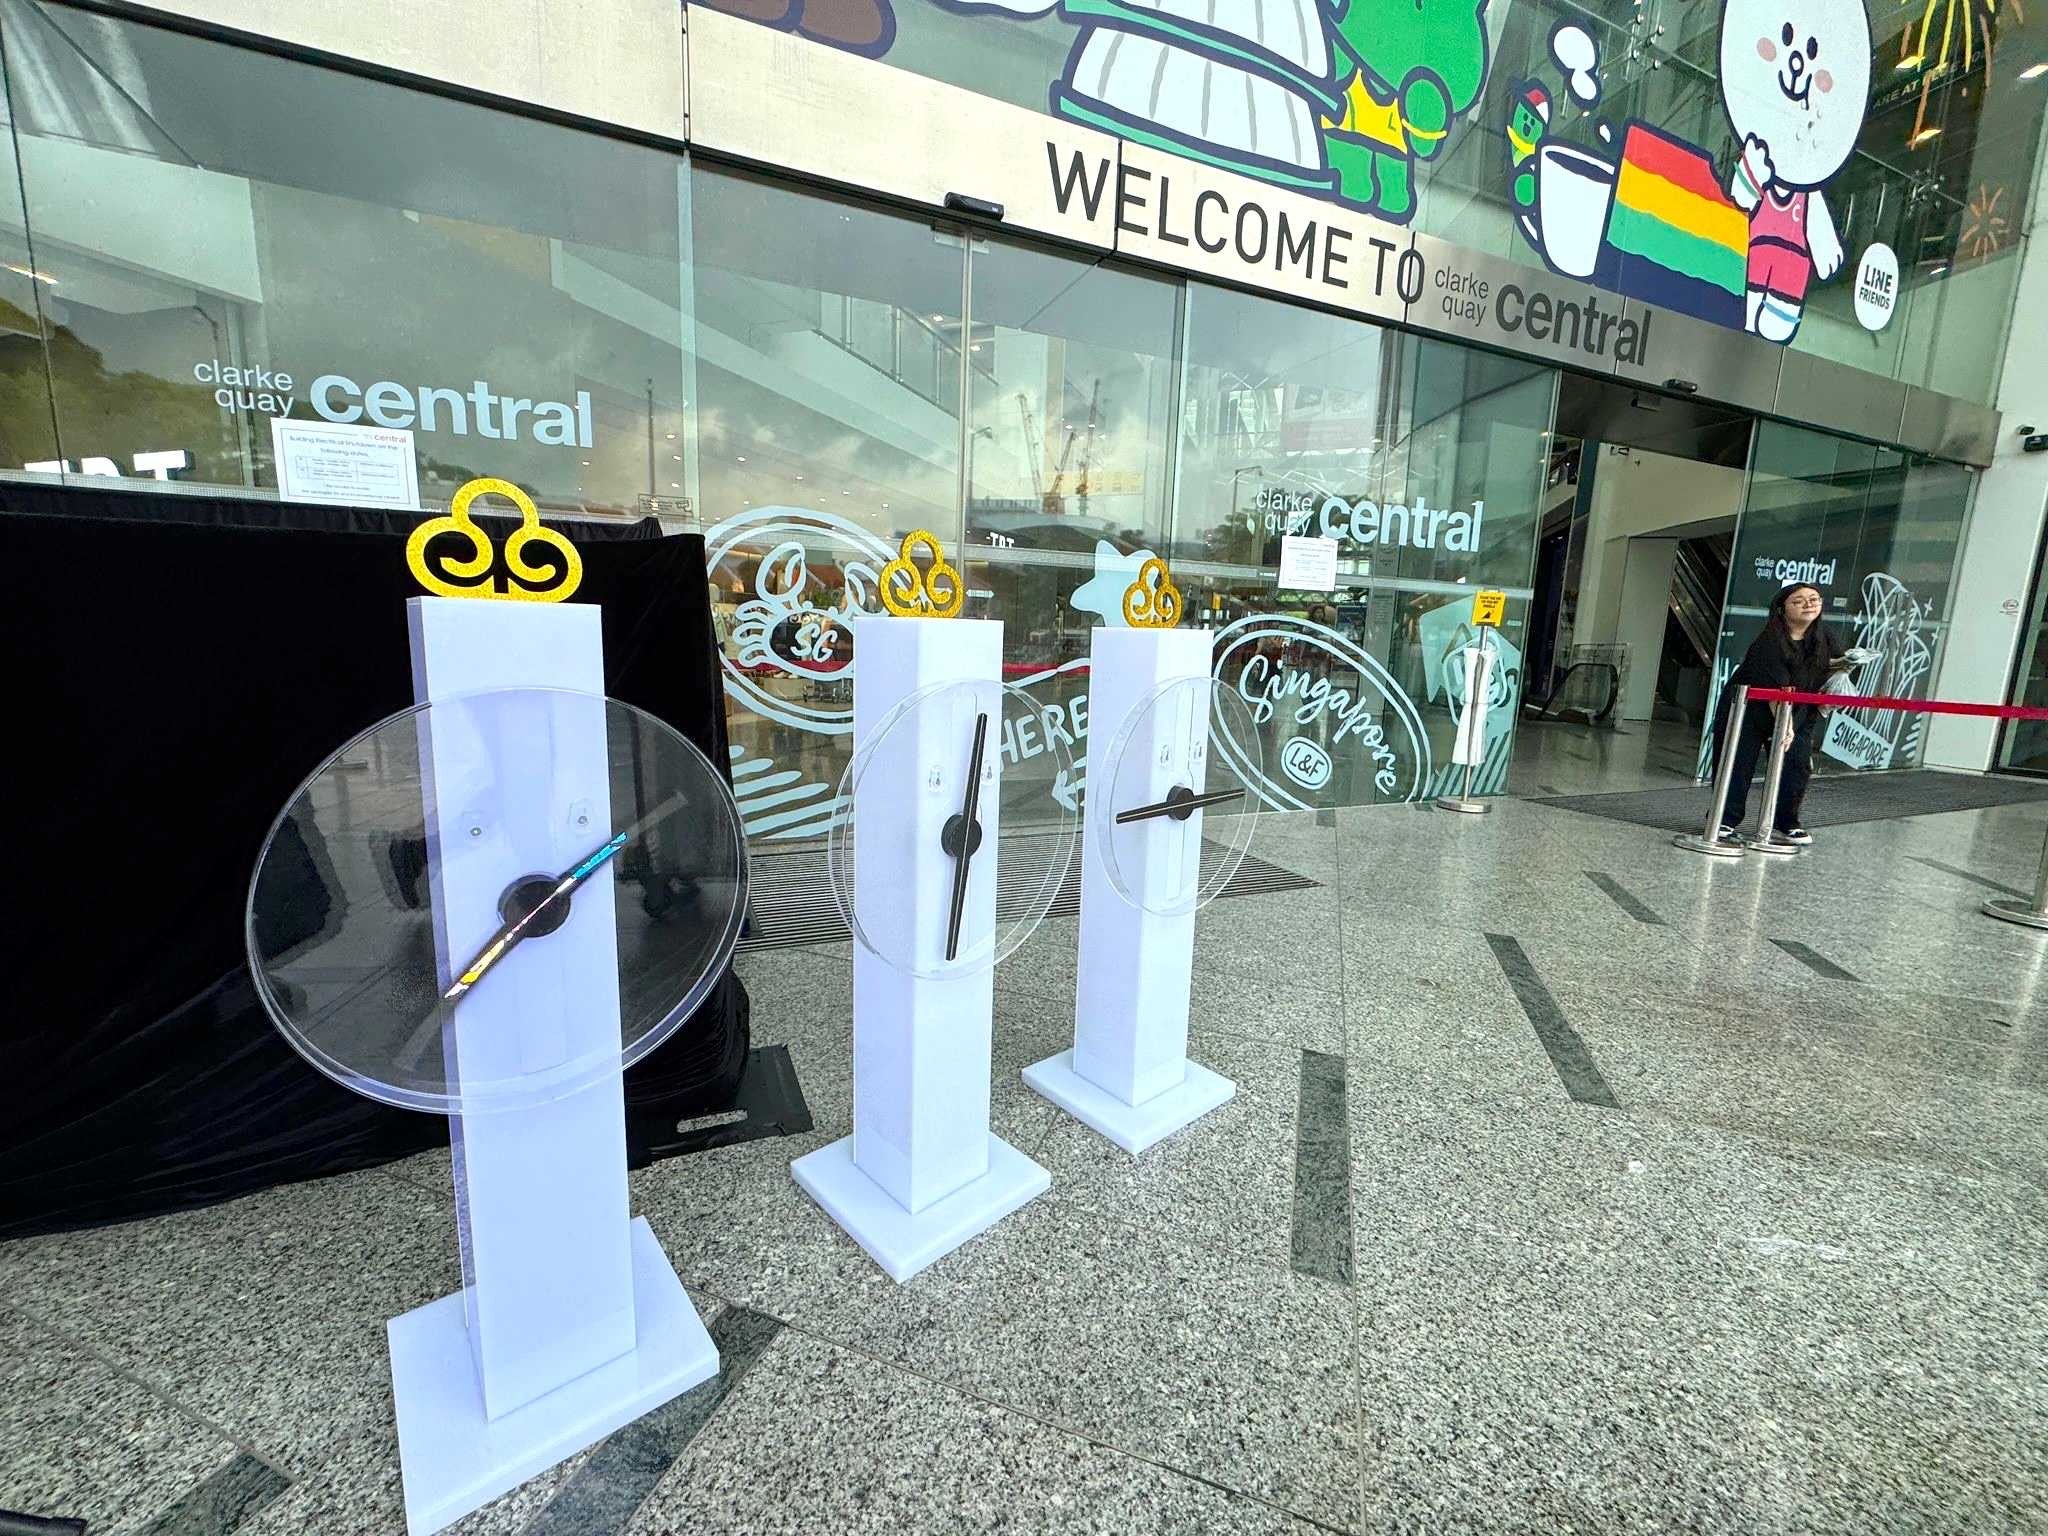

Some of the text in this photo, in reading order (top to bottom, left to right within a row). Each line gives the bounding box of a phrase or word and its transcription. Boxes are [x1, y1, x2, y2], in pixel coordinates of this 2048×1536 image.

[1046, 141, 1425, 305] WELCOME TO
[1434, 264, 1489, 299] clarke
[1863, 264, 1893, 294] LINE
[1442, 294, 1487, 328] quay
[1859, 286, 1891, 310] FRIENDS
[1495, 284, 1651, 366] central
[193, 360, 294, 391] clarke
[214, 388, 294, 418] quay
[310, 374, 593, 448] central
[1256, 488, 1313, 513] clarke
[1264, 510, 1311, 537] quay
[1319, 496, 1484, 552] central
[1755, 556, 1775, 568] clarke
[1756, 567, 1774, 580] quay
[1775, 557, 1836, 585] central
[790, 623, 838, 663] SG
[1000, 694, 1088, 773] HERE
[1239, 654, 1398, 795] Singapore
[1832, 721, 1889, 768] SINGAPORE
[1289, 747, 1324, 778] L&F
